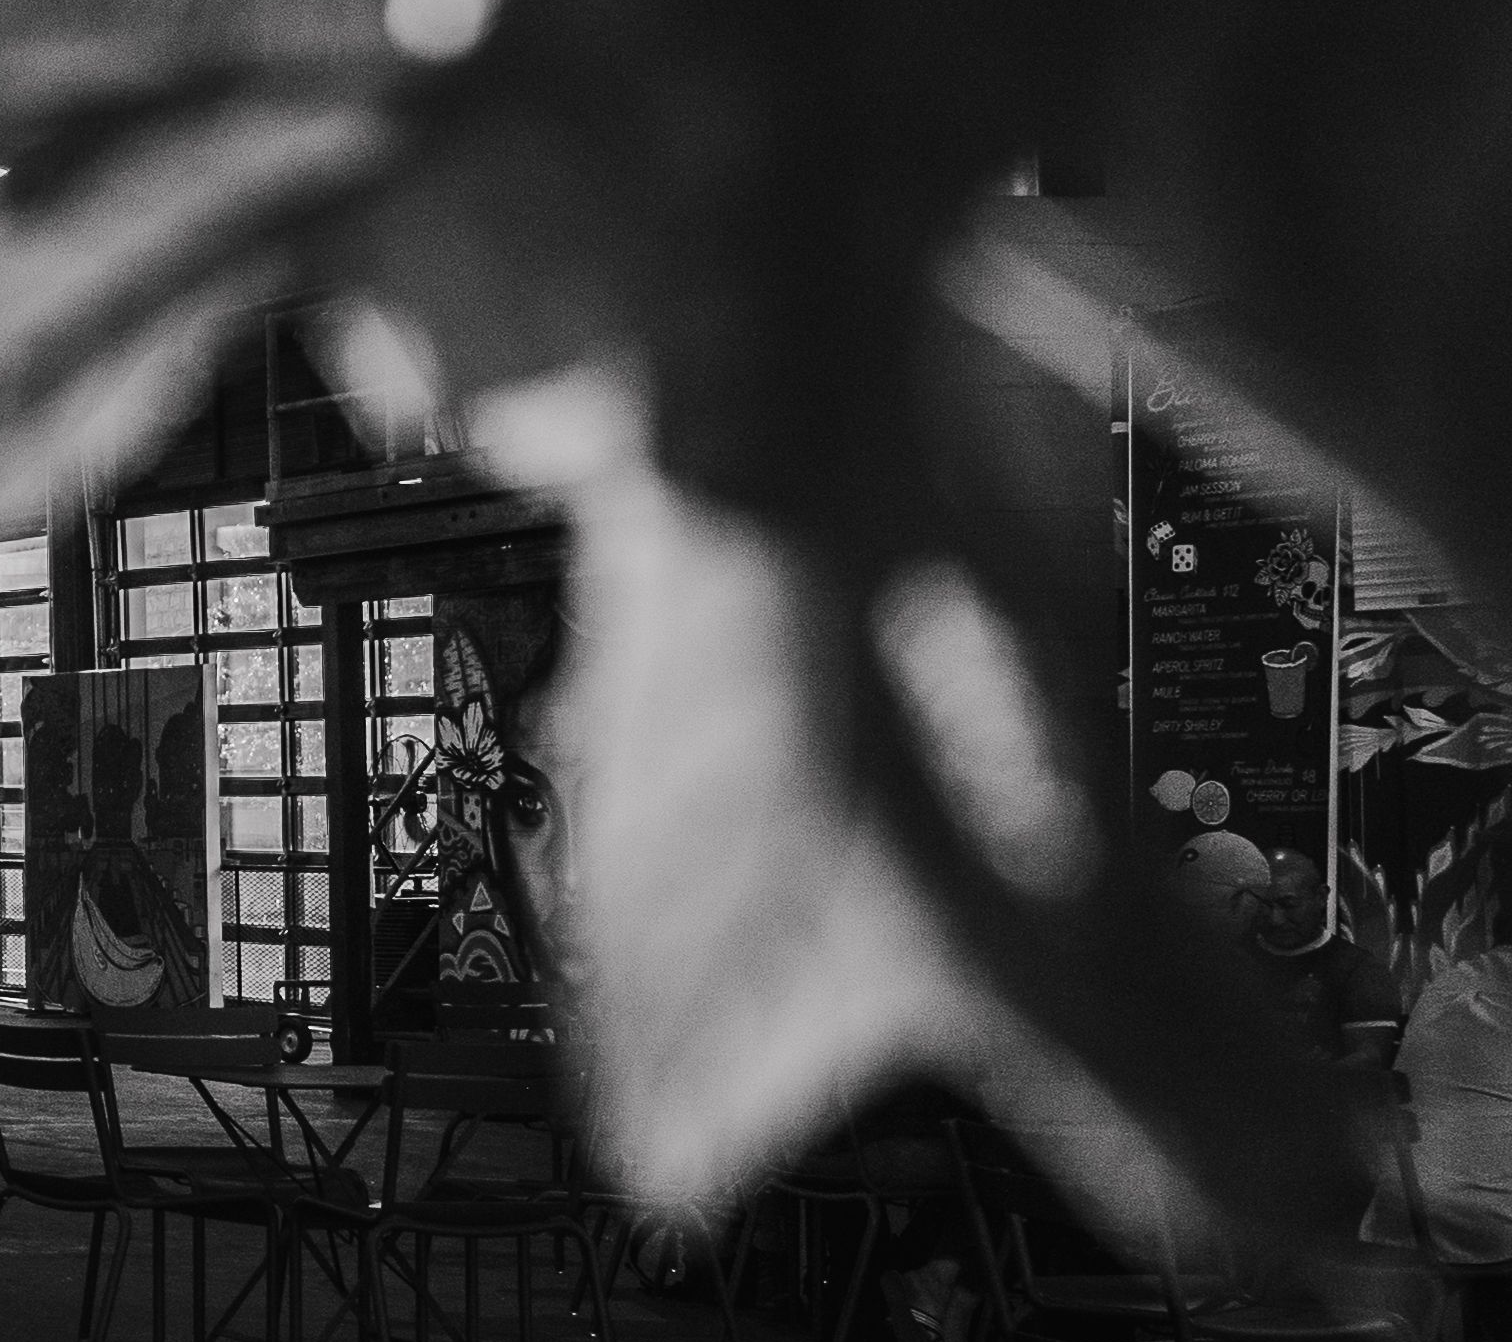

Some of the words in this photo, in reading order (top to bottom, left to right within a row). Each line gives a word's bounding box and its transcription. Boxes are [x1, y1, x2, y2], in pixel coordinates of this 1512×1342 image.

[1151, 603, 1207, 618] MARGARITA
[1151, 631, 1188, 645] RANCH
[1187, 628, 1222, 643] WATER
[1152, 659, 1193, 674] APEROL
[1193, 657, 1225, 671] SPRITZ
[1152, 686, 1182, 700] MULE
[1152, 719, 1182, 733] DIRTY
[1183, 718, 1224, 732] SHIRLEY
[1246, 789, 1289, 803] CHERRY
[1290, 789, 1308, 803] OR
